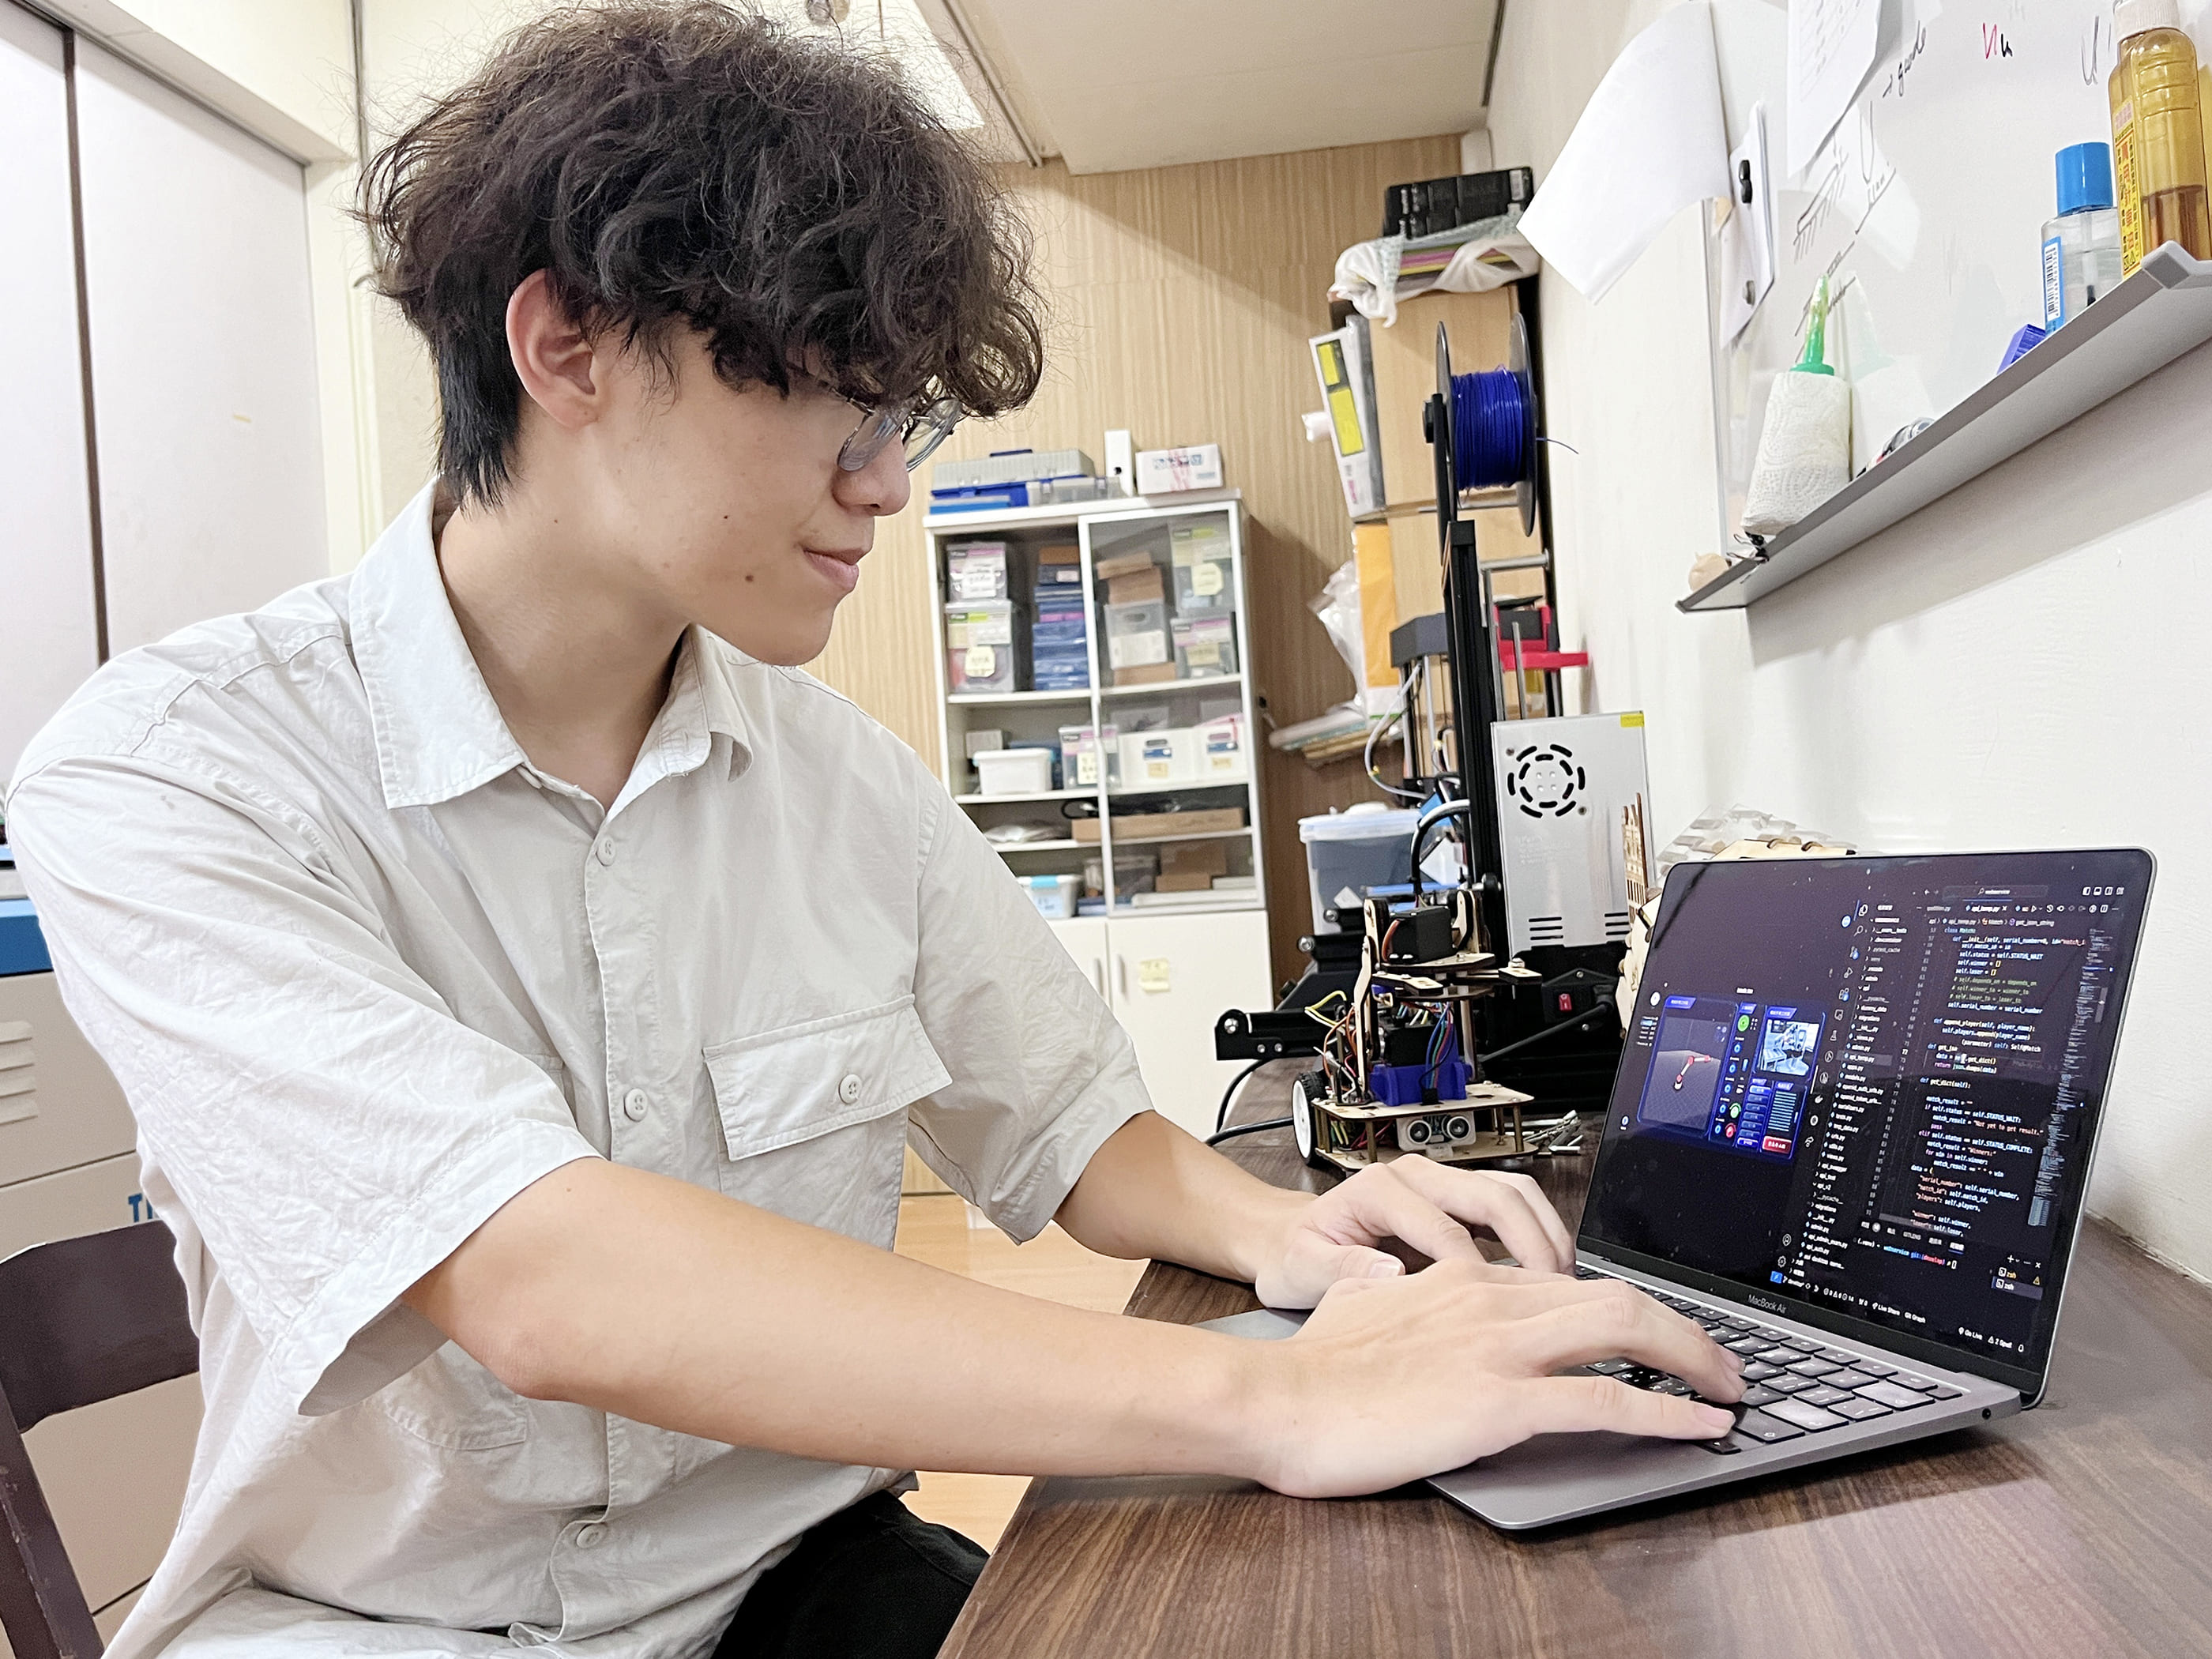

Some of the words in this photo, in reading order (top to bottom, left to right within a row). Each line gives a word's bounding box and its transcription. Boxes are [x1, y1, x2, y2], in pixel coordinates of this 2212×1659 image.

[1932, 1105, 1962, 1115] self.status
[1932, 1132, 1962, 1143] self.status
[1747, 1294, 1777, 1312] MacBook
[1777, 1303, 1787, 1315] Air
[1912, 1314, 1926, 1323] Graph
